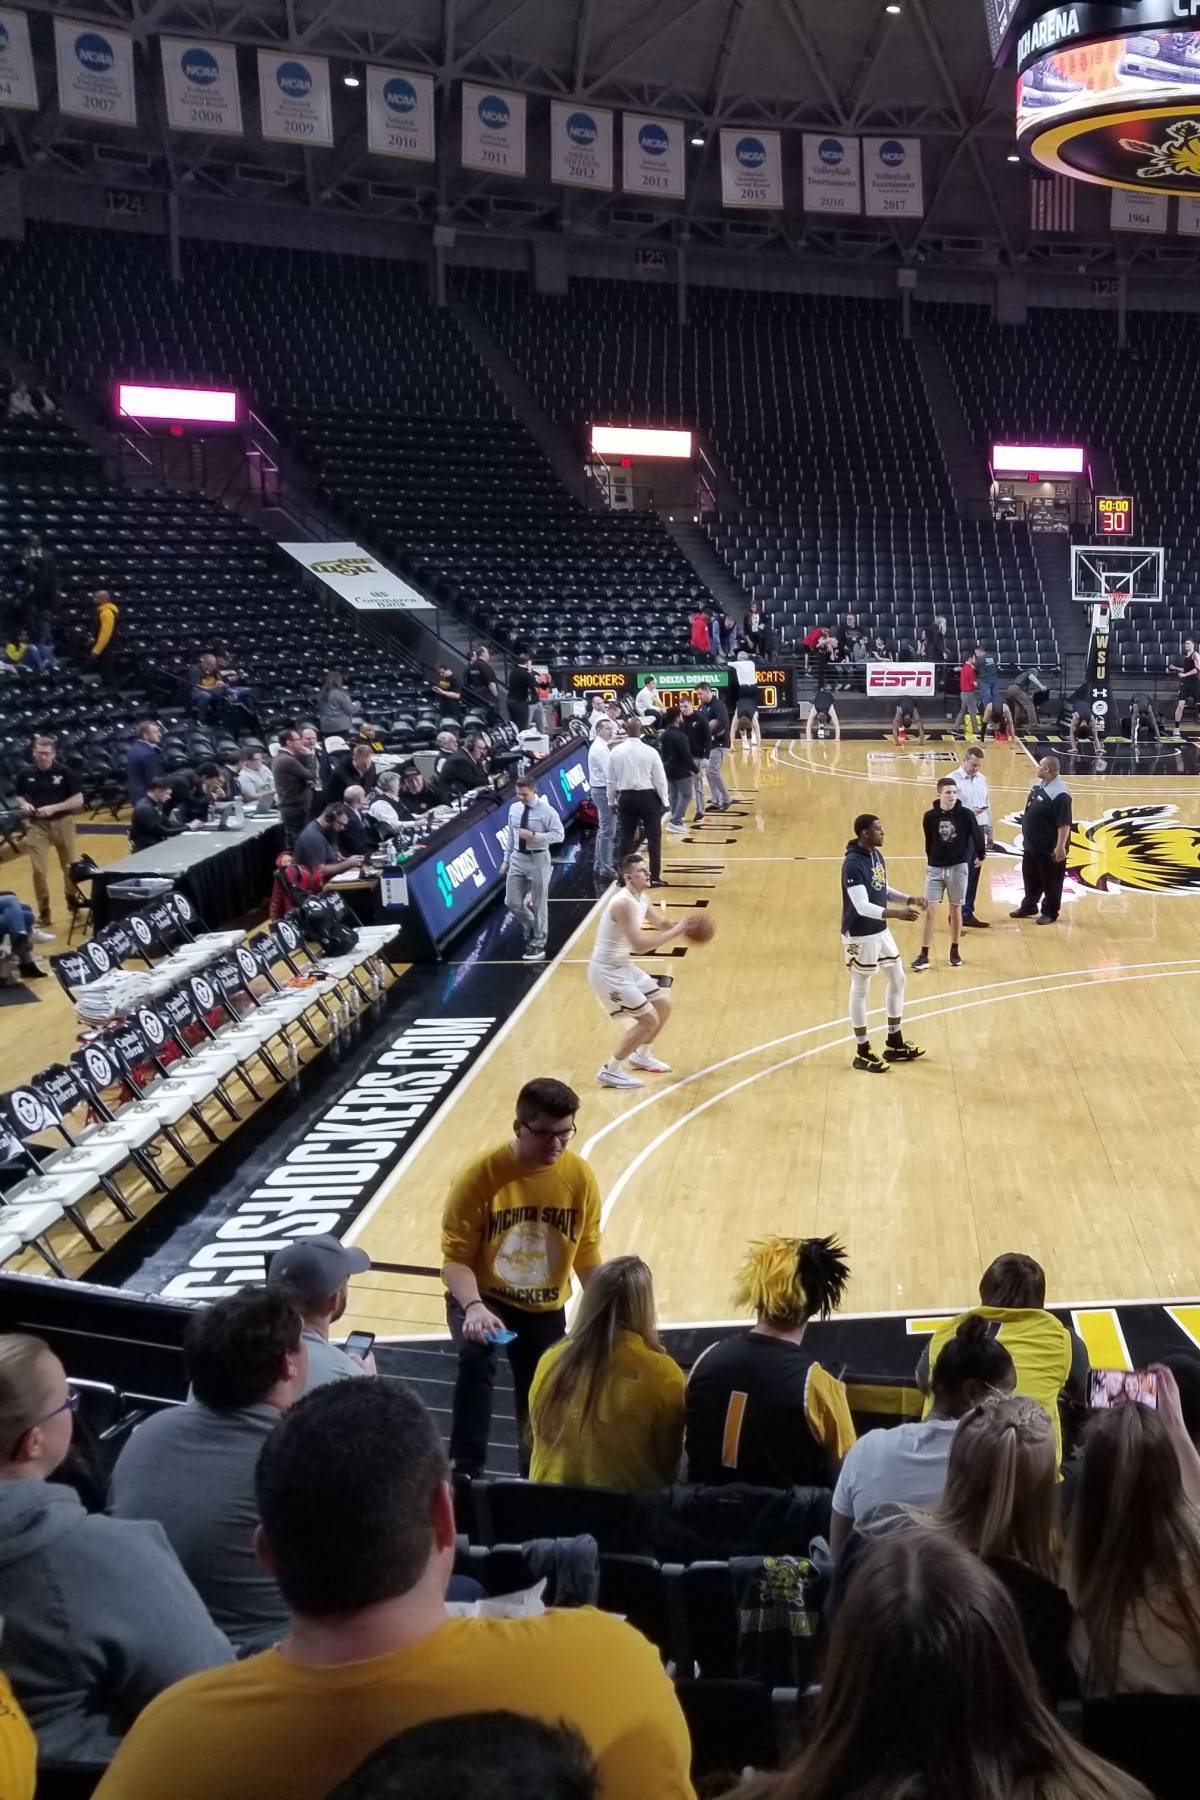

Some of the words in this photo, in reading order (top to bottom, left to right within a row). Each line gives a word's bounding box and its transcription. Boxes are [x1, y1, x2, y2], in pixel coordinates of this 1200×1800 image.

[1030, 8, 1079, 51] ARENA
[79, 49, 113, 65] NCAA
[185, 63, 219, 77] NCAA
[280, 78, 312, 91] NCAA
[82, 95, 116, 111] 2007
[386, 92, 417, 106] NCAA
[190, 108, 223, 123] 2008
[480, 109, 509, 121] NCAA
[282, 119, 314, 134] 2009
[569, 126, 598, 138] NCAA
[387, 134, 417, 149] 2010
[640, 137, 669, 149] NCAA
[480, 150, 507, 164] 2011
[739, 150, 766, 161] NCAA
[819, 150, 846, 161] NCAA
[881, 152, 906, 162] NCAA
[568, 166, 596, 179] 2012
[812, 164, 852, 178] Volleyball
[643, 174, 669, 188] 2013
[807, 176, 857, 188] Tournament
[739, 188, 767, 201] 2015
[107, 191, 143, 214] 124
[881, 198, 906, 211] 2017
[1128, 212, 1152, 225] 1964
[635, 248, 666, 265] 125
[1099, 501, 1129, 512] 60:00
[1103, 512, 1125, 531] 30
[1095, 635, 1109, 680] WSU
[573, 673, 625, 687] SHOCKERS
[659, 674, 690, 684] DELTA
[691, 675, 720, 684] DENTAL
[754, 670, 786, 683] RCATS
[869, 670, 932, 687] ESPN
[164, 994, 184, 1011] Capitol
[171, 1003, 191, 1021] Federal
[114, 1031, 137, 1049] Capitol
[121, 1041, 145, 1057] Federal
[44, 1071, 72, 1093] Capitol
[53, 1085, 78, 1102] Federal
[160, 1017, 497, 1299] GOSHOCKERS.COM
[489, 1207, 538, 1241] WICHITA
[541, 1207, 578, 1244] STATE
[489, 1285, 559, 1303] SHOCKERS
[721, 1390, 748, 1470] 1
